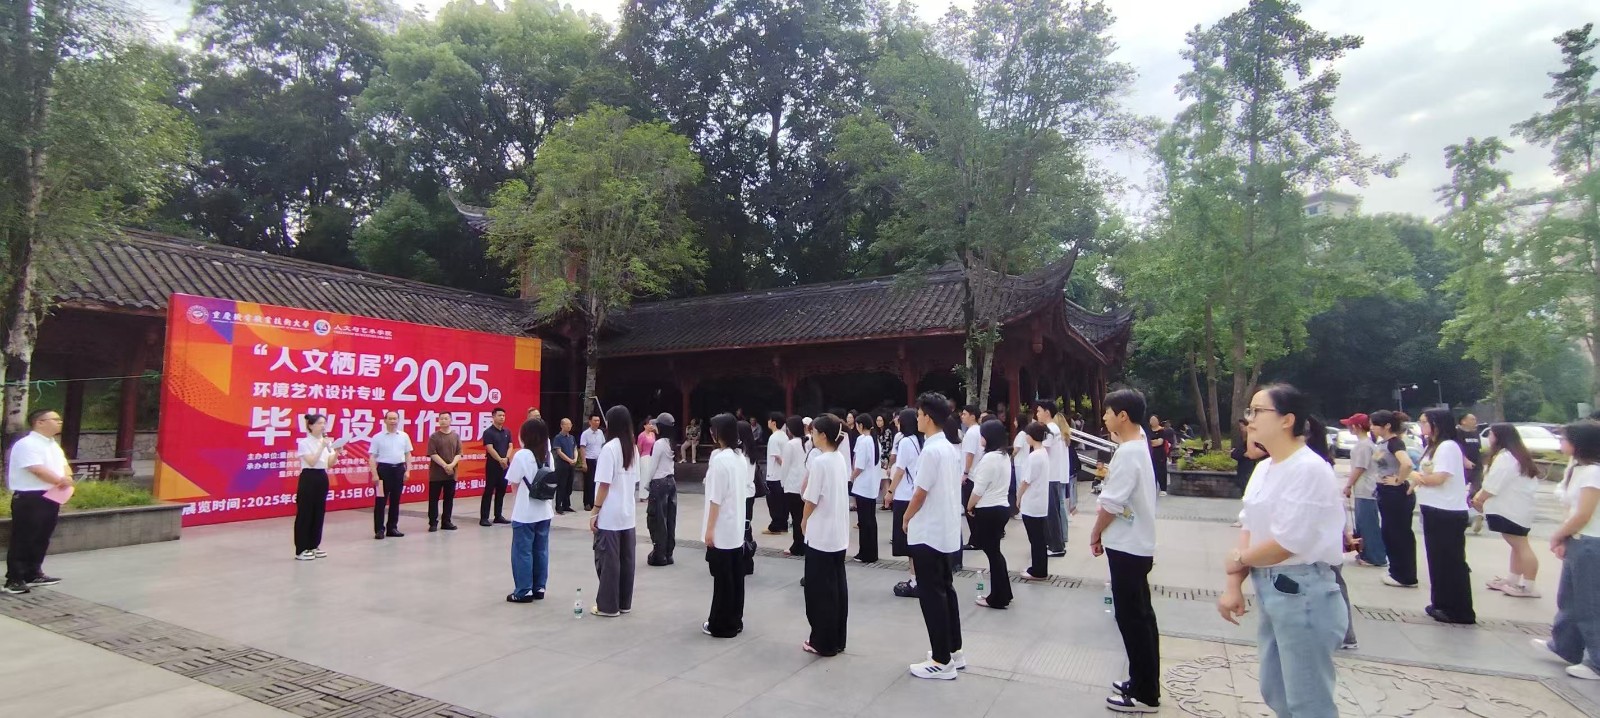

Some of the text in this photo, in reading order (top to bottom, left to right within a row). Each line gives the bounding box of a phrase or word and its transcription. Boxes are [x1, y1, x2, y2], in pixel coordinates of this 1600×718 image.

[252, 382, 386, 401] 环境艺术设计专业
